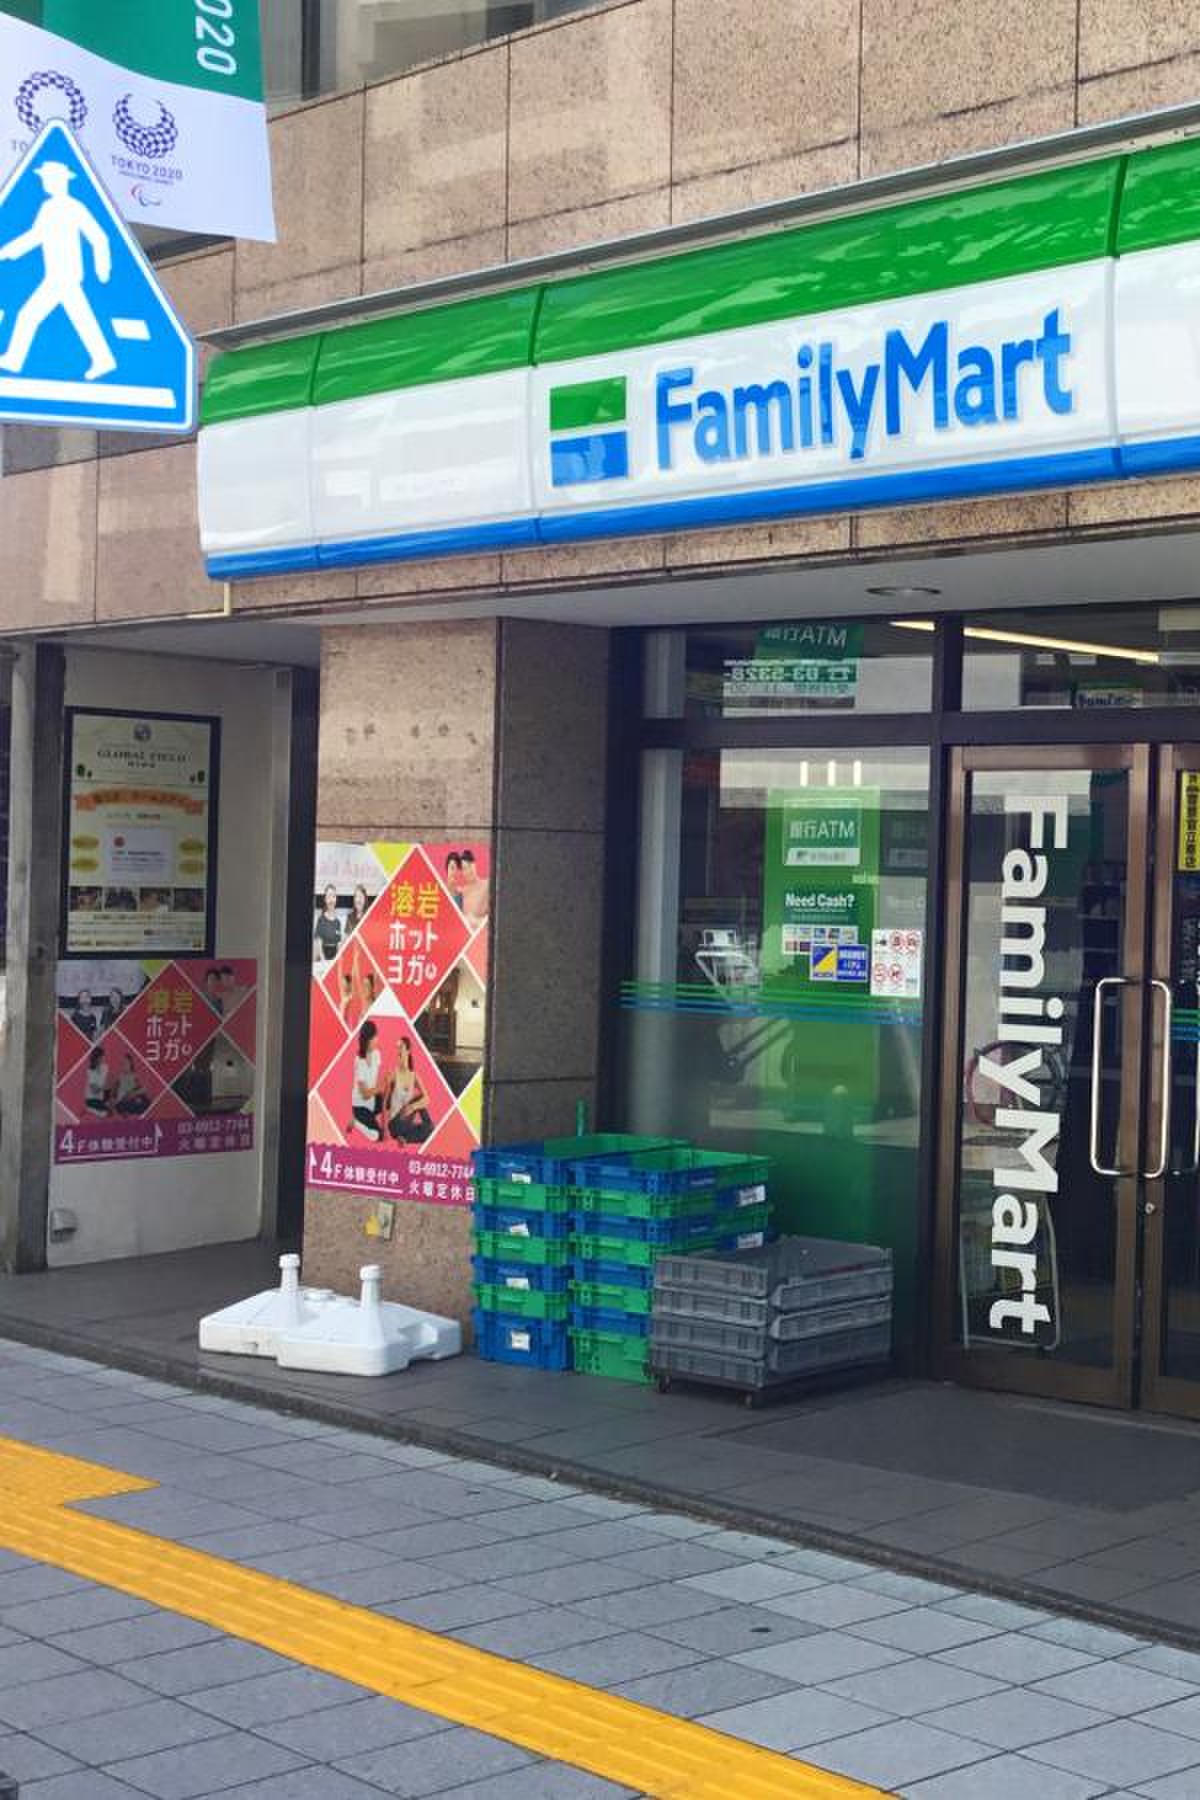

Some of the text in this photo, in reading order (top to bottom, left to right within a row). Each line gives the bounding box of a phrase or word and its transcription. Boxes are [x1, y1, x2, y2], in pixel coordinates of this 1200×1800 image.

[111, 155, 150, 175] TOKYO
[152, 163, 183, 180] 2020
[656, 307, 1073, 470] FamilyMart
[785, 892, 855, 908] Need Cash?
[389, 920, 439, 952] ホット
[979, 791, 1069, 1335] FamilyMart
